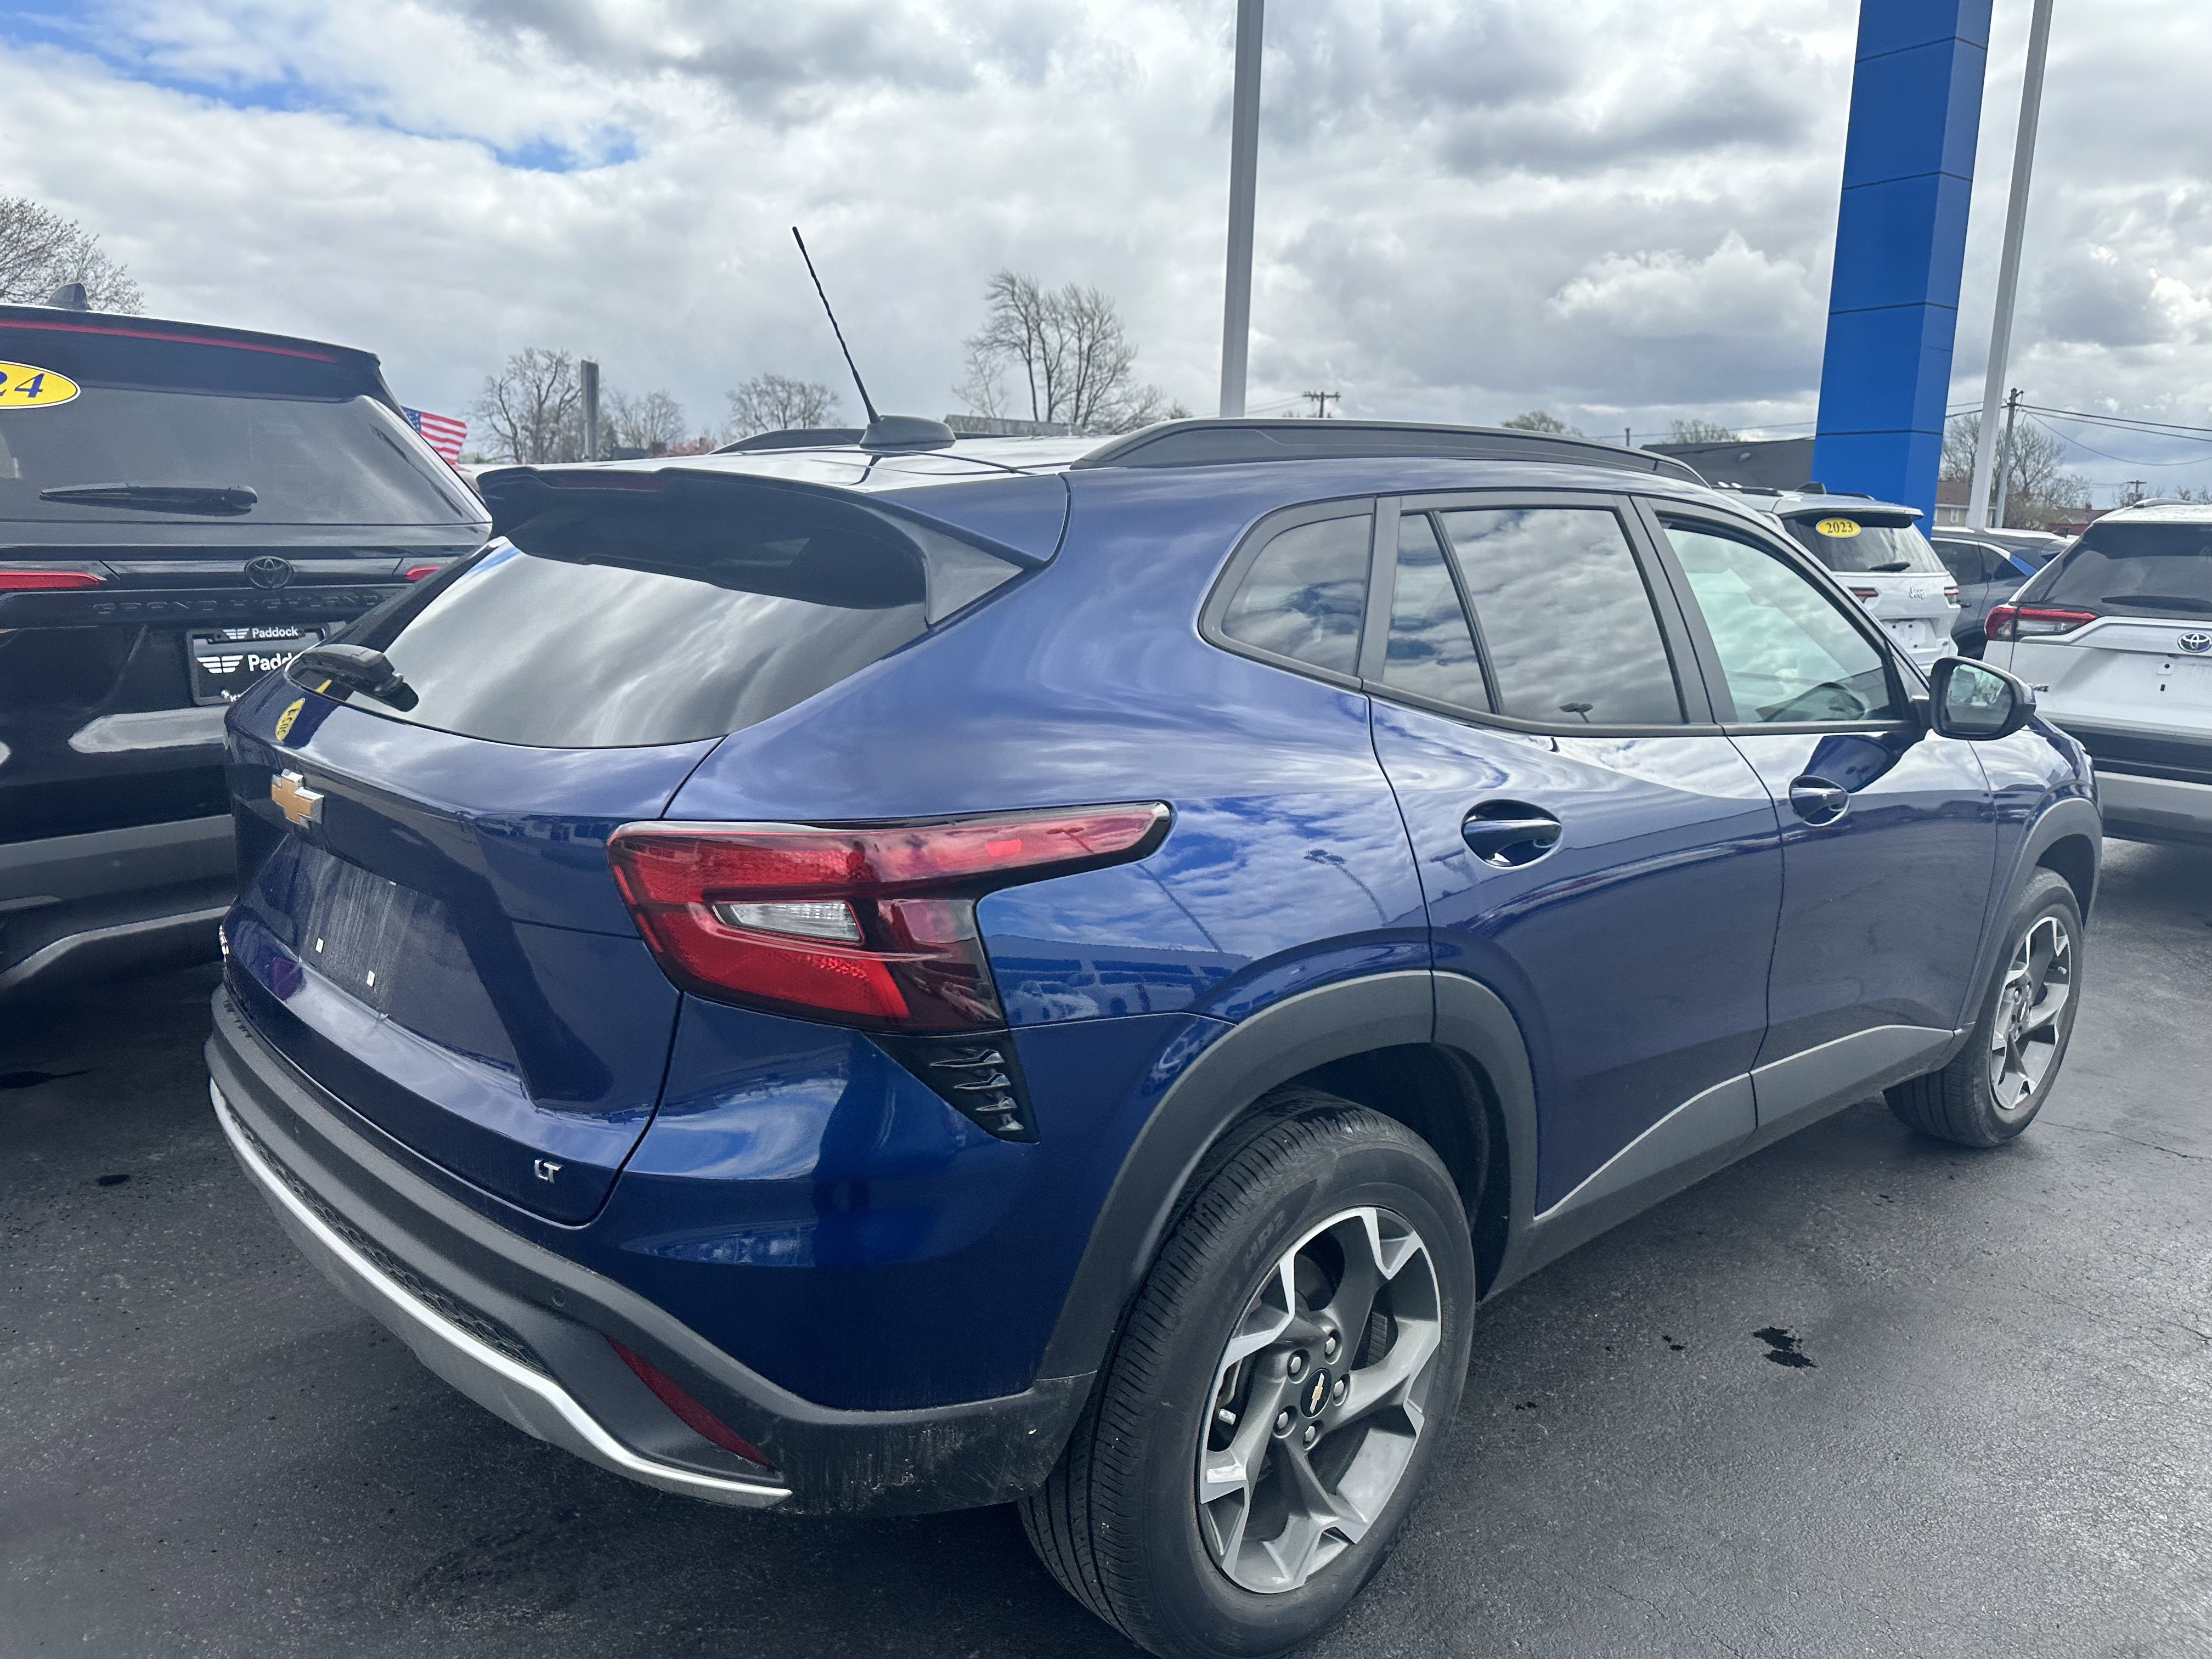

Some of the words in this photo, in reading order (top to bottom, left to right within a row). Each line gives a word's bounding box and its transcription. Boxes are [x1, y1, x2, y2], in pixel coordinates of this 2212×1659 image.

[1825, 522, 1853, 533] 2023
[1909, 588, 1926, 600] Jeep
[252, 626, 299, 639] Paddock
[534, 1159, 563, 1183] LT
